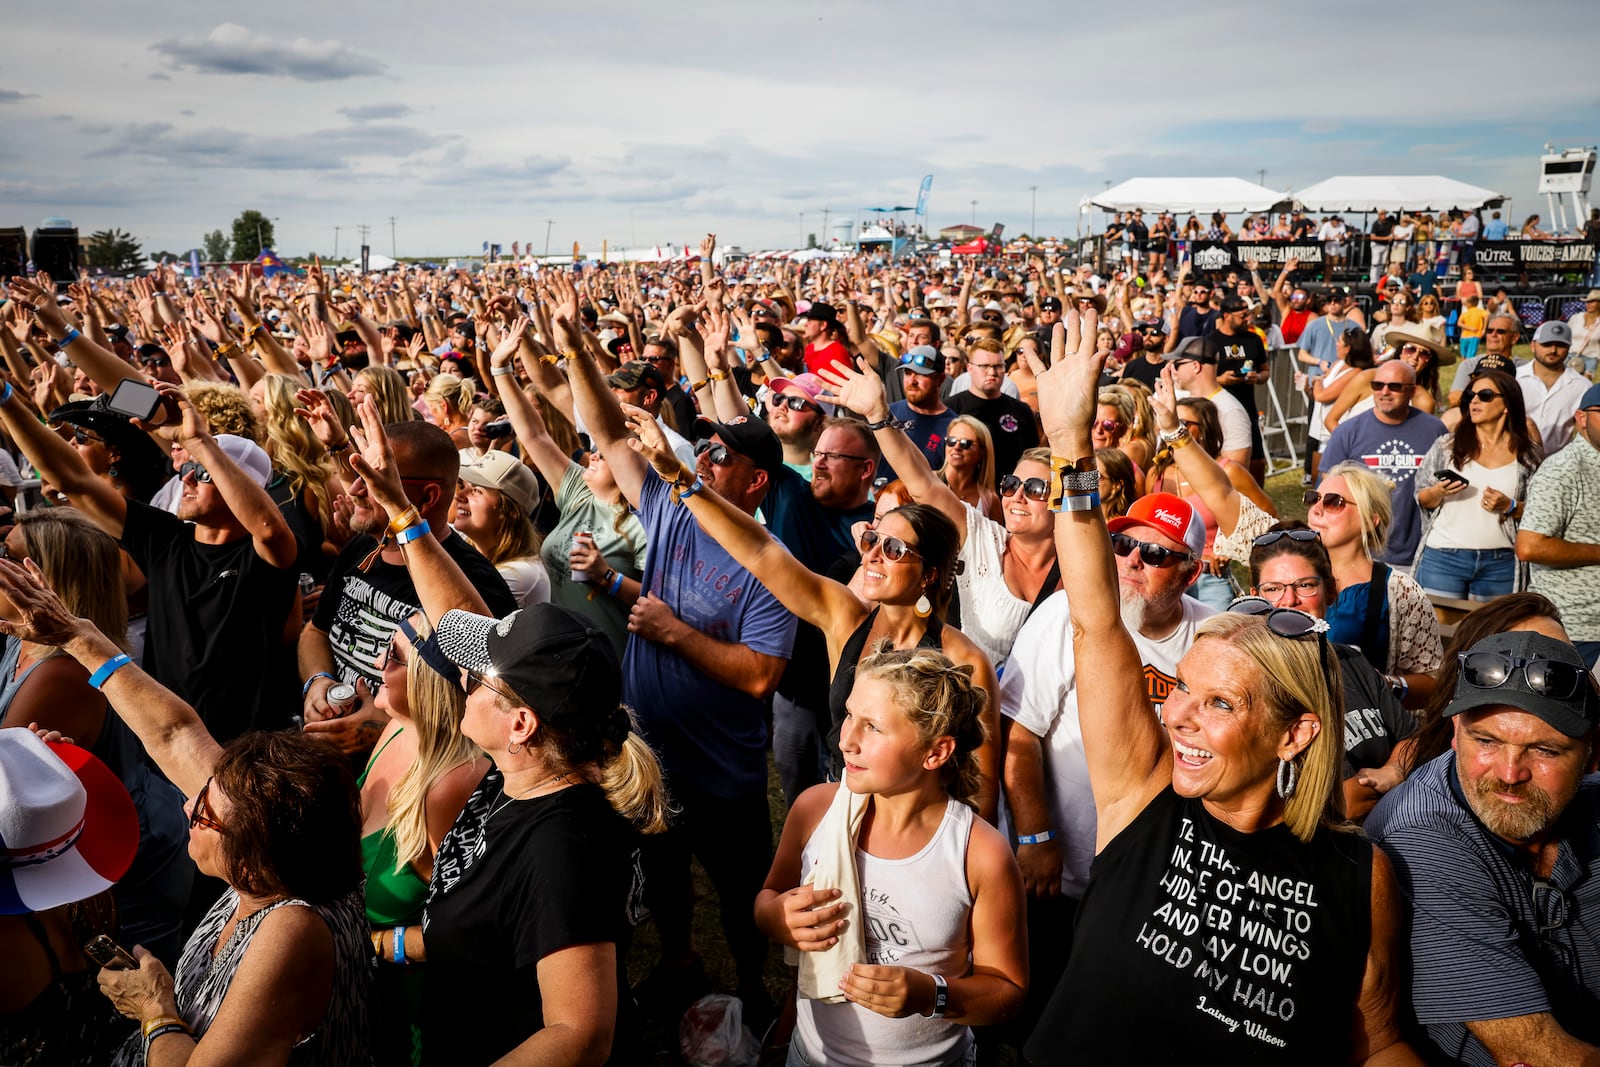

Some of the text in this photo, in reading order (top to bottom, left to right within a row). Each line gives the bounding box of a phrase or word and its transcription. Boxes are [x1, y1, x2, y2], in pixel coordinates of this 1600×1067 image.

[1194, 252, 1231, 265] BUSCH
[1237, 246, 1272, 262] VOICES
[1277, 246, 1322, 263] AMERICA
[1520, 244, 1555, 262] VOICES
[1379, 454, 1416, 466] TOP GUN
[372, 590, 392, 616] AND
[1200, 840, 1241, 876] THA
[1245, 870, 1319, 908] ANGEL
[1159, 868, 1198, 907] HIDE
[1239, 915, 1312, 961] WINGS
[1216, 879, 1246, 906] OF
[1282, 906, 1312, 934] TO
[1152, 901, 1293, 988] AND AY LOW.
[1135, 921, 1296, 1022] HOLD MY HALO
[1195, 995, 1287, 1048] Lainey Wilson
